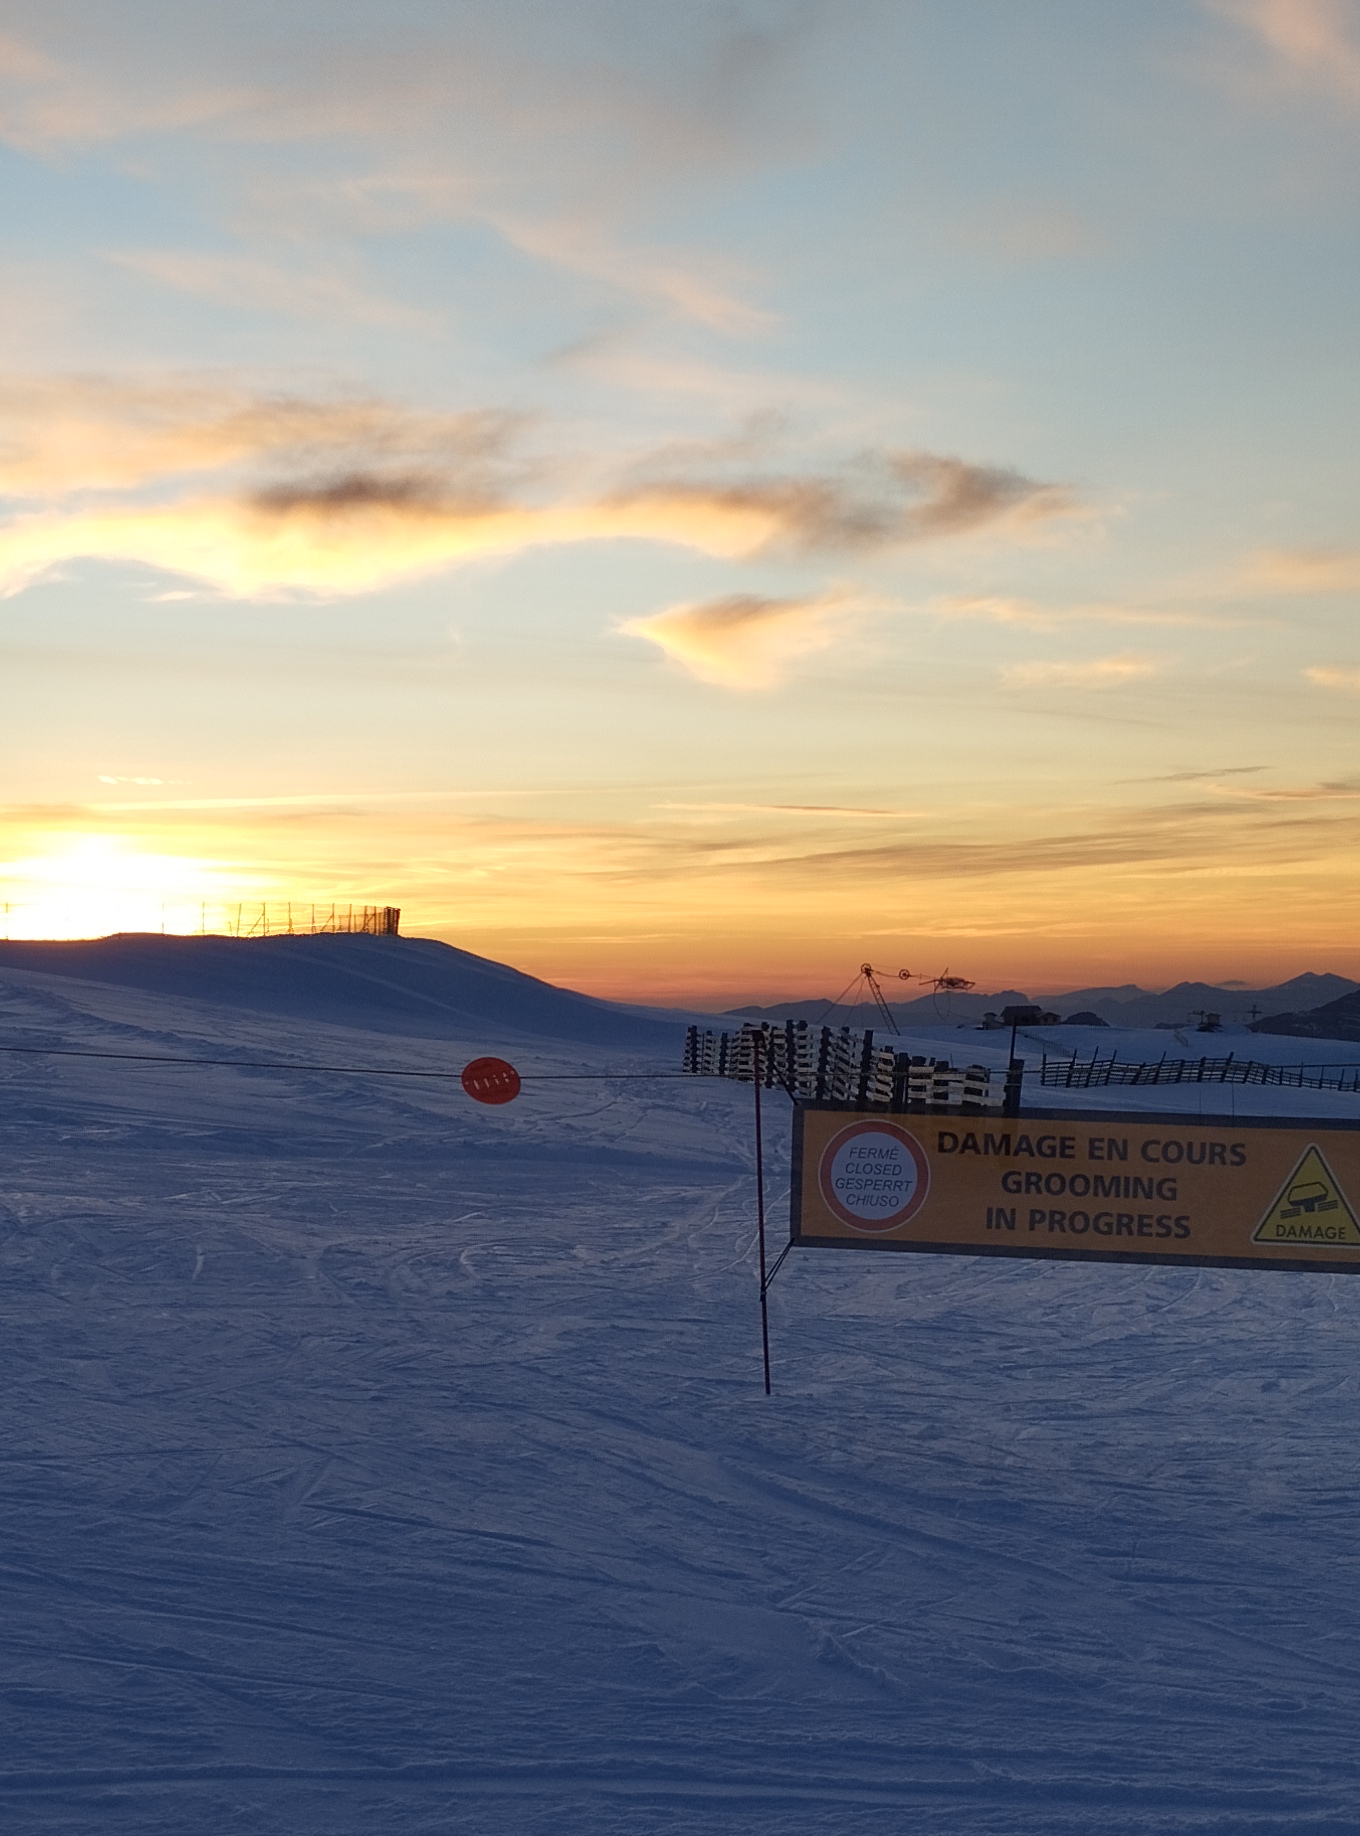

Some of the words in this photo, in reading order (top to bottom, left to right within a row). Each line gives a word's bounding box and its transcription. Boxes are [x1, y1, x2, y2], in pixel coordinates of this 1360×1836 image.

[849, 1146, 900, 1160] FERMÉ
[937, 1131, 1076, 1159] DAMAGE
[1088, 1137, 1128, 1162] EN
[1141, 1139, 1247, 1167] COURS
[845, 1162, 902, 1176] CLOSED
[835, 1177, 913, 1192] GESPERRT
[1001, 1170, 1177, 1201] GROOMING
[846, 1193, 899, 1207] CHIUSO
[985, 1207, 1016, 1231] IN
[1028, 1208, 1191, 1239] PROGRESS
[1276, 1224, 1346, 1240] DAMAGE
